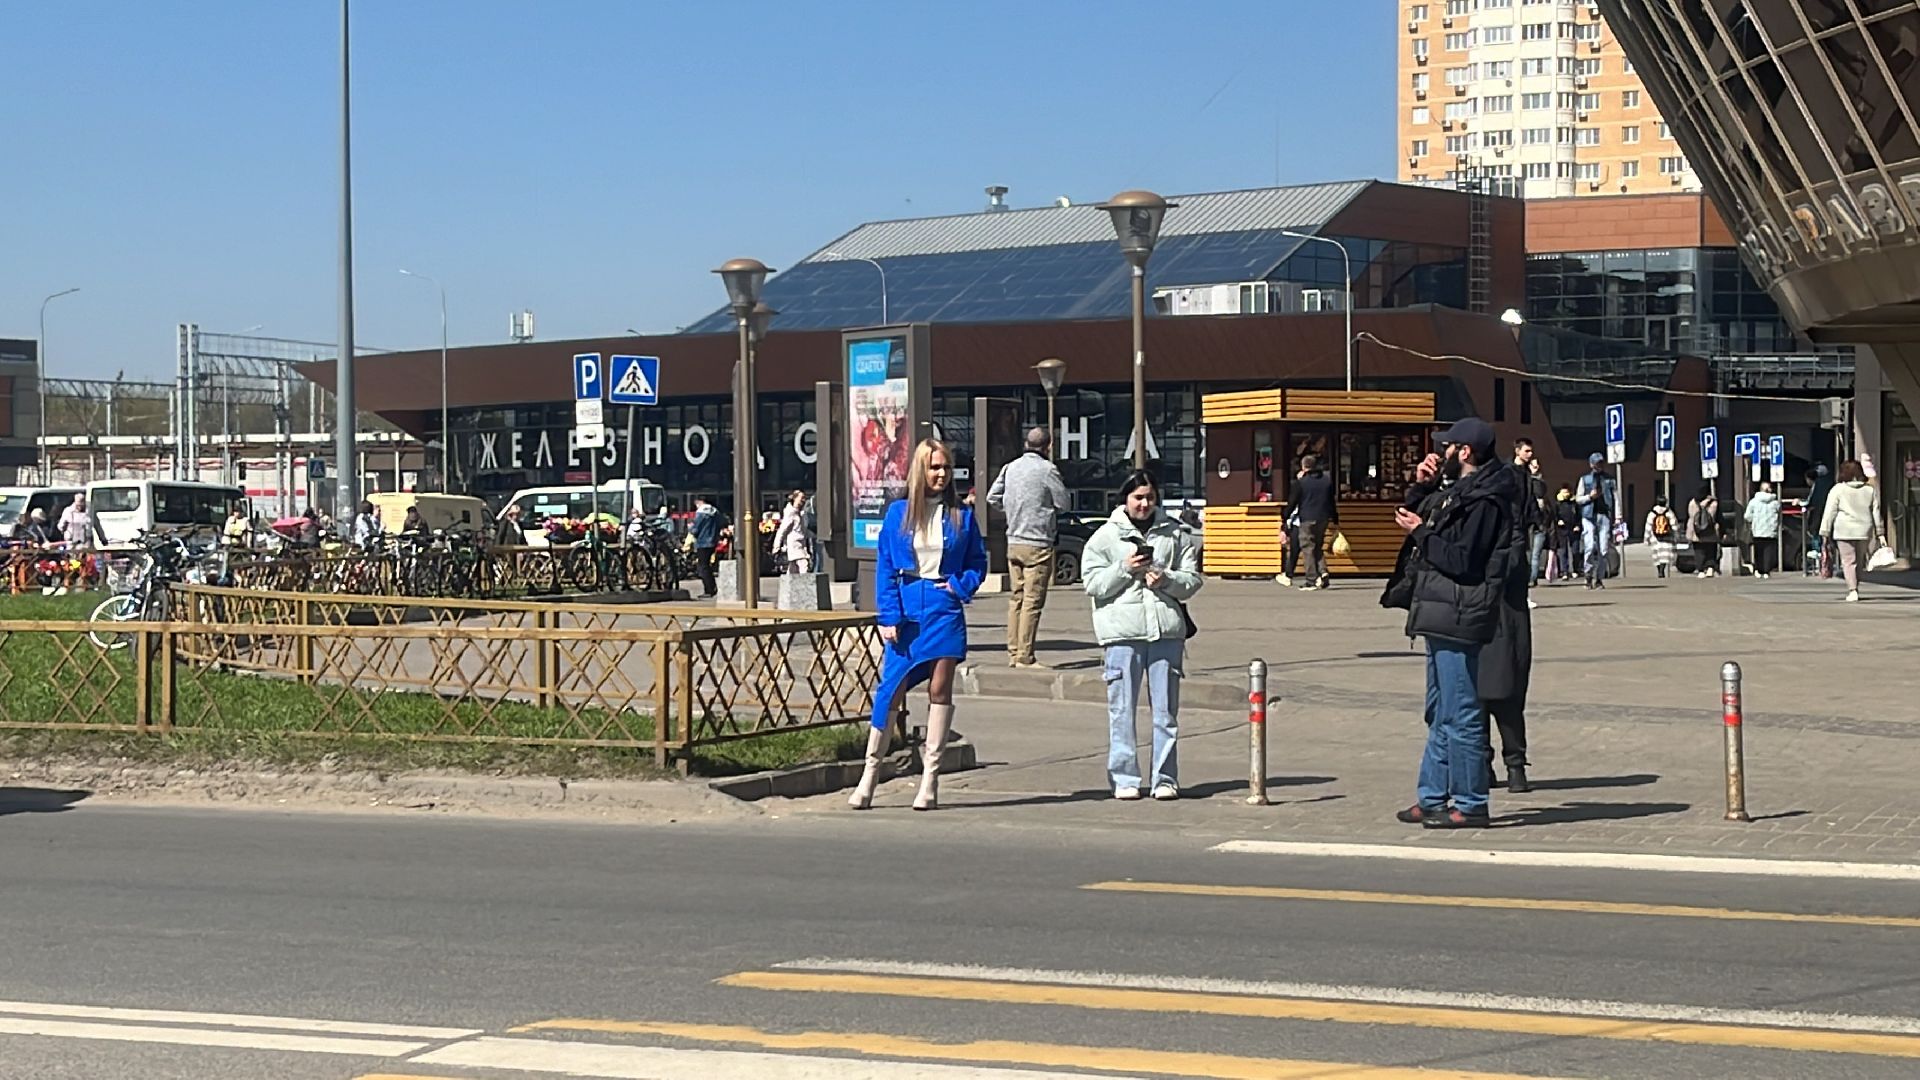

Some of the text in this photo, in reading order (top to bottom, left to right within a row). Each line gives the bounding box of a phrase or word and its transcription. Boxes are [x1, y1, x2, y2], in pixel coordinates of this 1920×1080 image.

[582, 359, 597, 396] P
[1610, 409, 1620, 440] P
[1660, 420, 1671, 449] P
[1704, 432, 1714, 458] P
[1772, 440, 1781, 464] P
